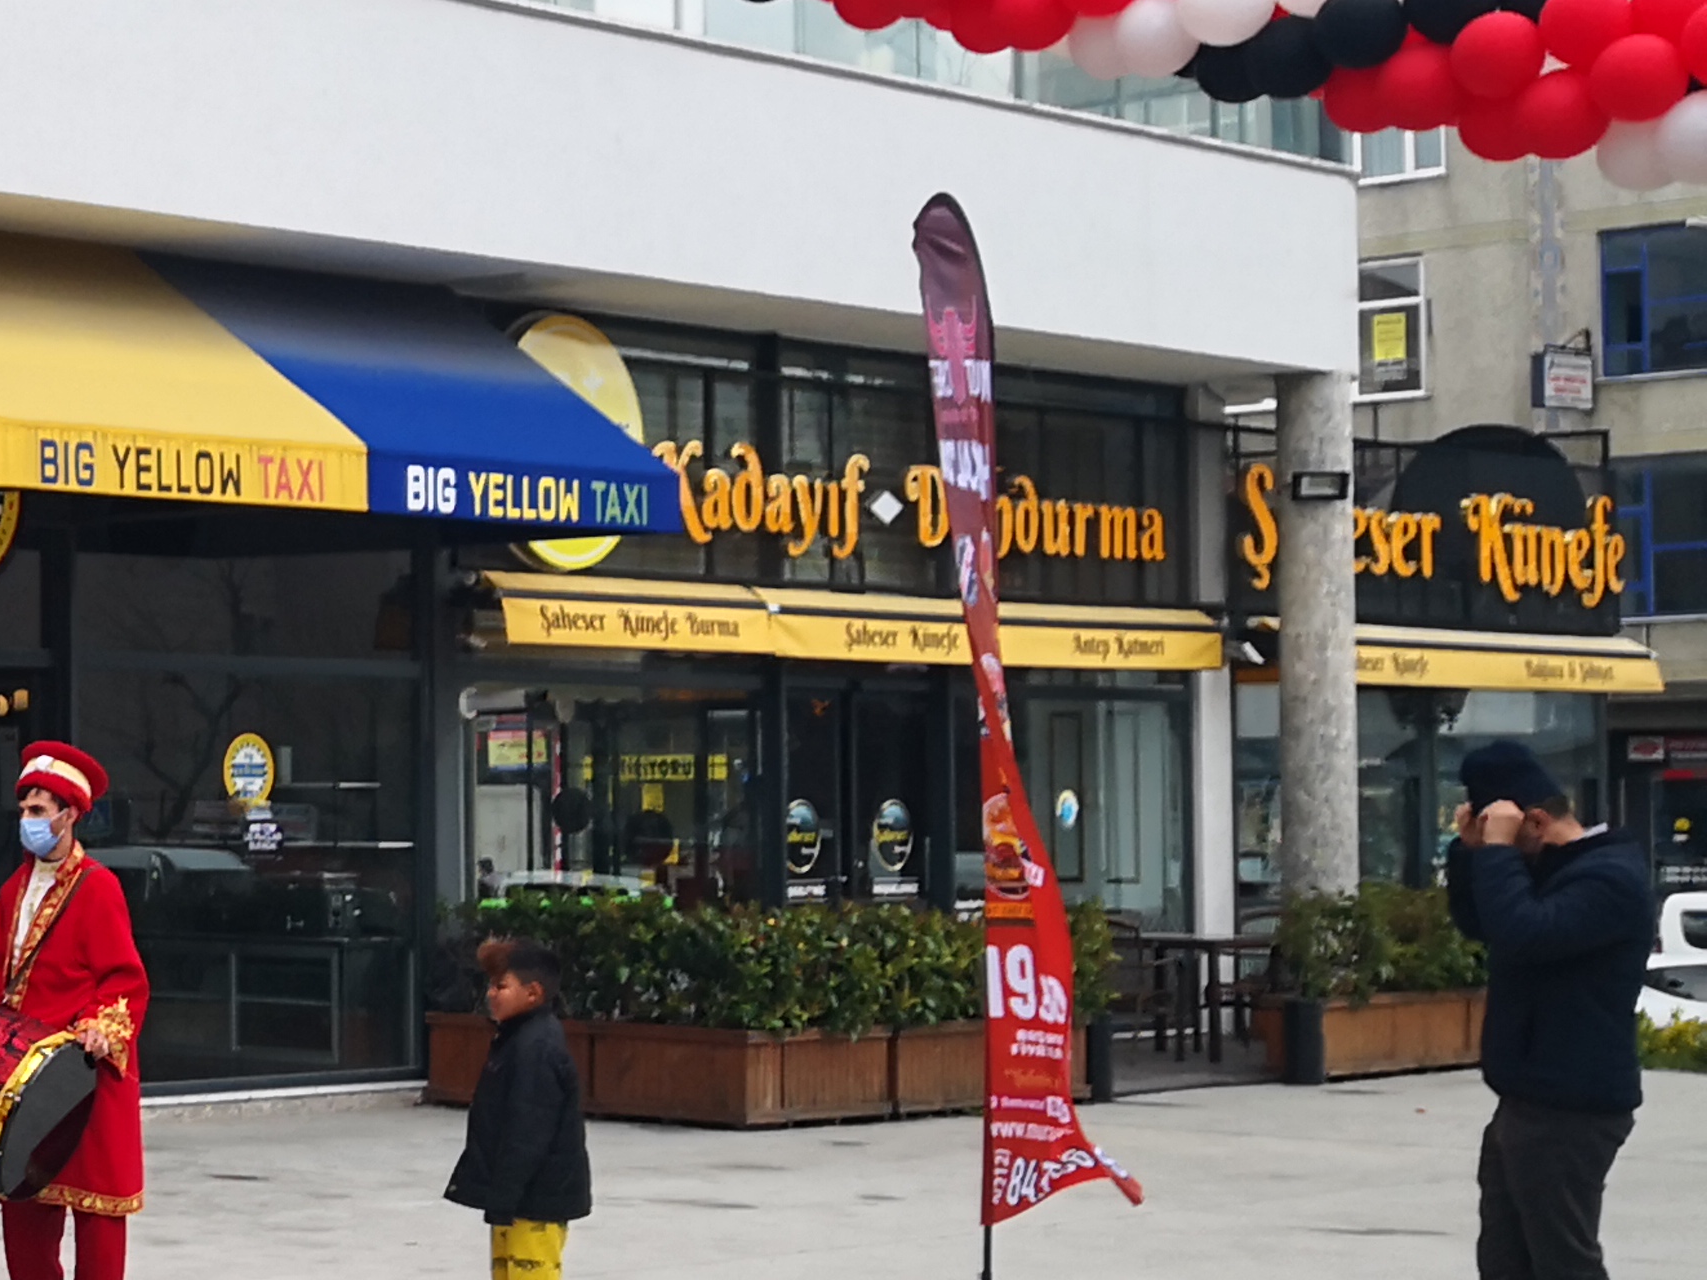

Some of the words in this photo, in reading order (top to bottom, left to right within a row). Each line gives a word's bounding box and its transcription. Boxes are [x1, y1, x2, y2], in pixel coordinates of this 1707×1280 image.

[38, 438, 95, 488] BIG
[113, 444, 242, 500] YELLOW
[257, 455, 325, 503] TAXI
[405, 463, 457, 515] BIG
[468, 471, 580, 523] YELLOW
[590, 480, 649, 526] TAXI
[1242, 463, 1442, 590] Şeser
[1460, 493, 1627, 608] Künefe
